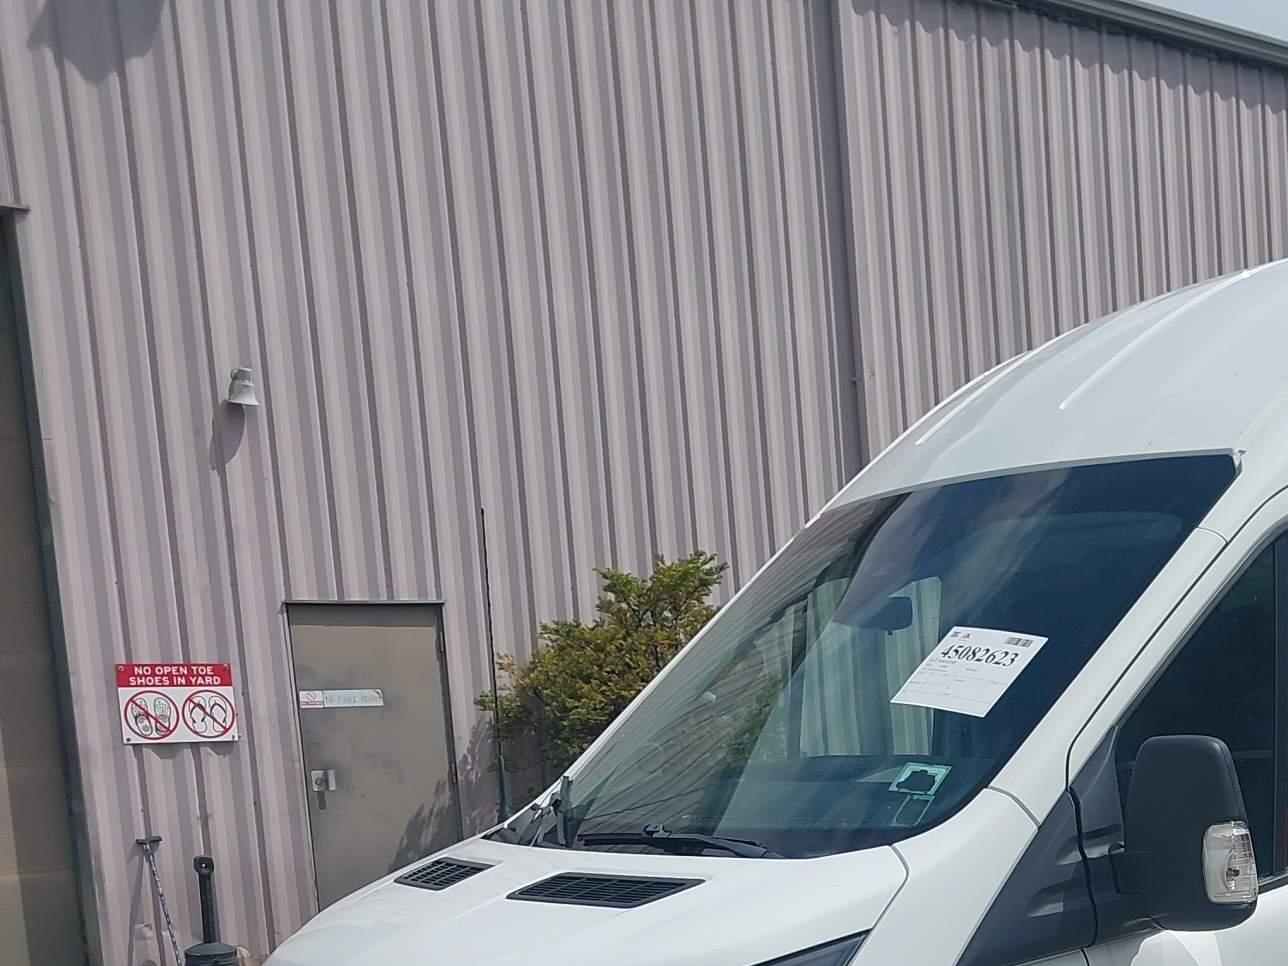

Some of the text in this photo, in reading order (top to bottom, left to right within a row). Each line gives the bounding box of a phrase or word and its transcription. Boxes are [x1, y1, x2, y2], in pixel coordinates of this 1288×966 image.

[940, 643, 1020, 668] 45082623
[134, 666, 214, 675] NO OPEN TOE
[129, 676, 221, 686] SHOES IN YARD
